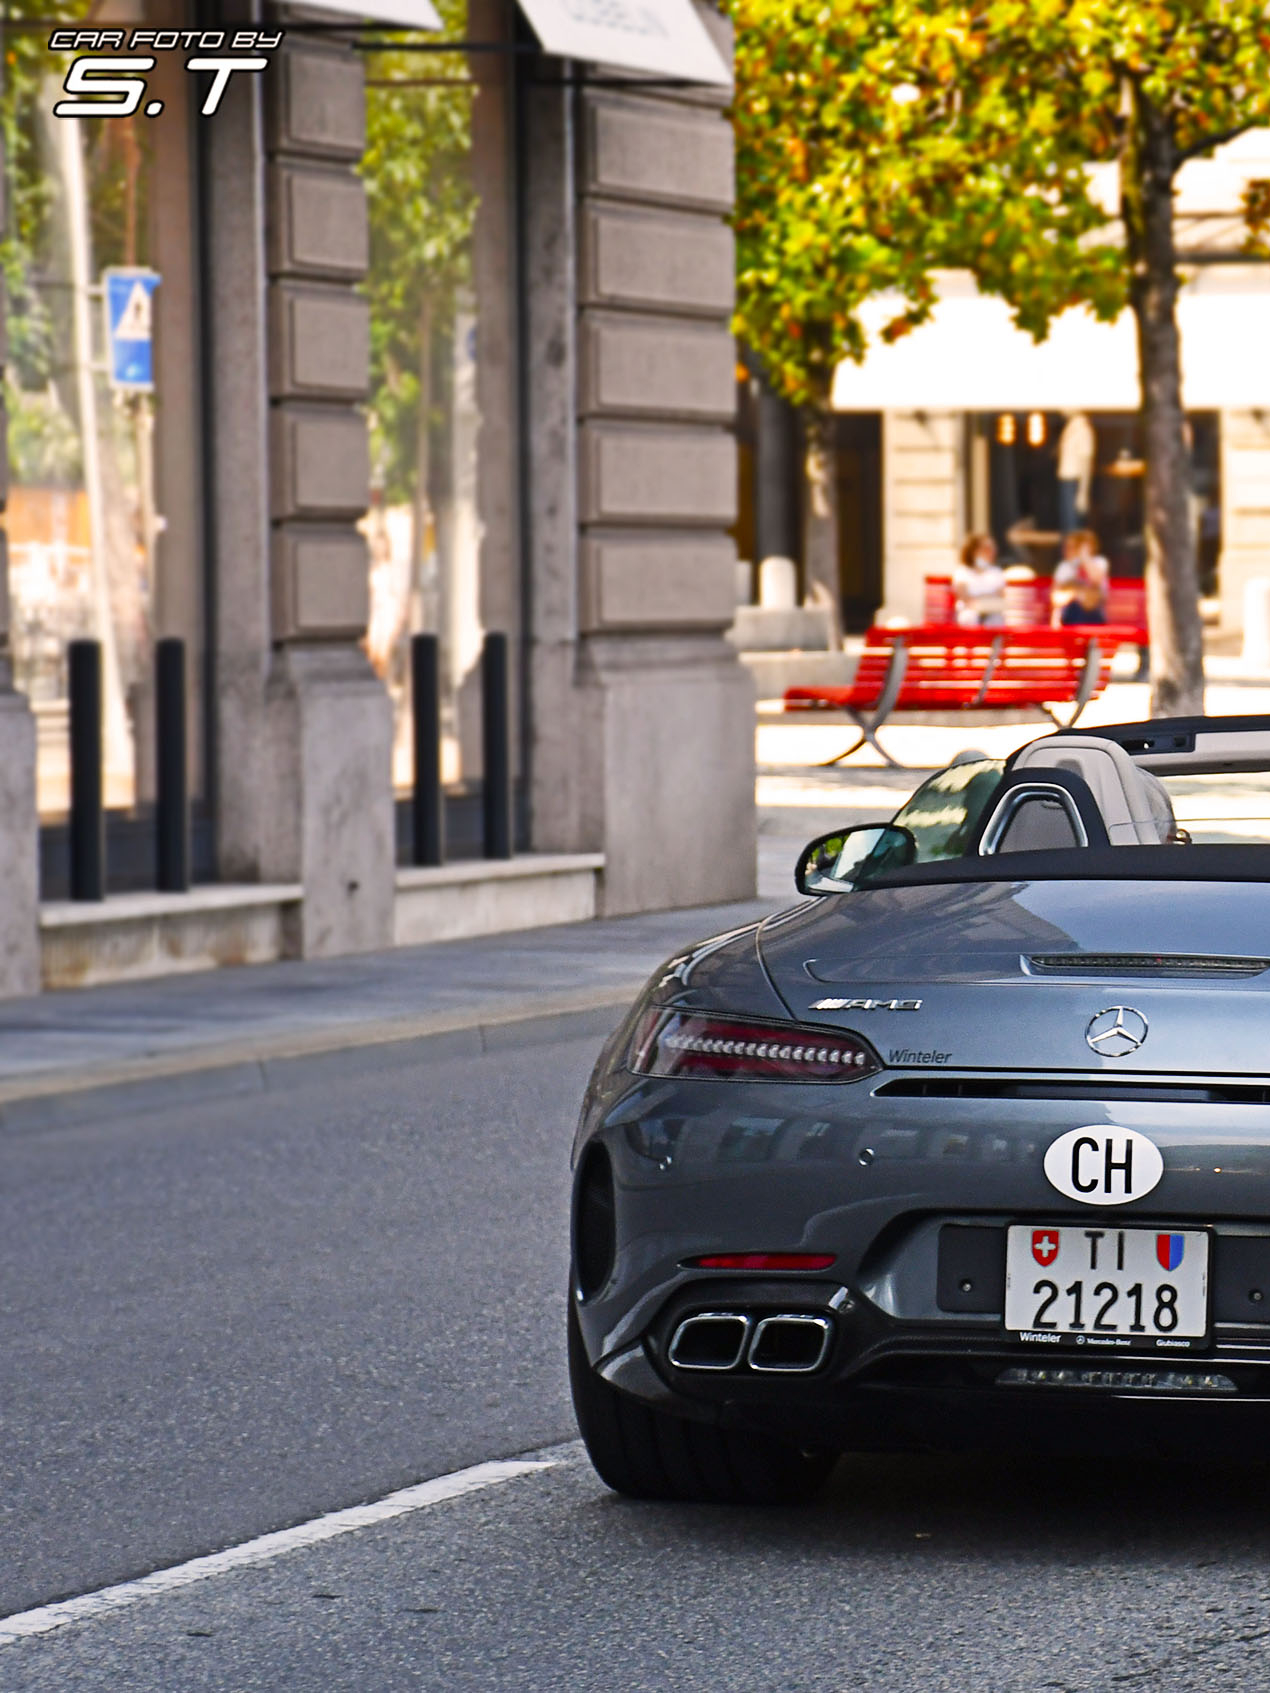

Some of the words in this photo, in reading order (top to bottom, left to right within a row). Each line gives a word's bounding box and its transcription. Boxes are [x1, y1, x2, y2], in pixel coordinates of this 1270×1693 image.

[889, 1049, 952, 1064] Winteler
[1071, 1136, 1133, 1194] CH
[1084, 1230, 1125, 1271] TI
[1032, 1279, 1179, 1333] 21218
[1019, 1331, 1062, 1344] Winteler
